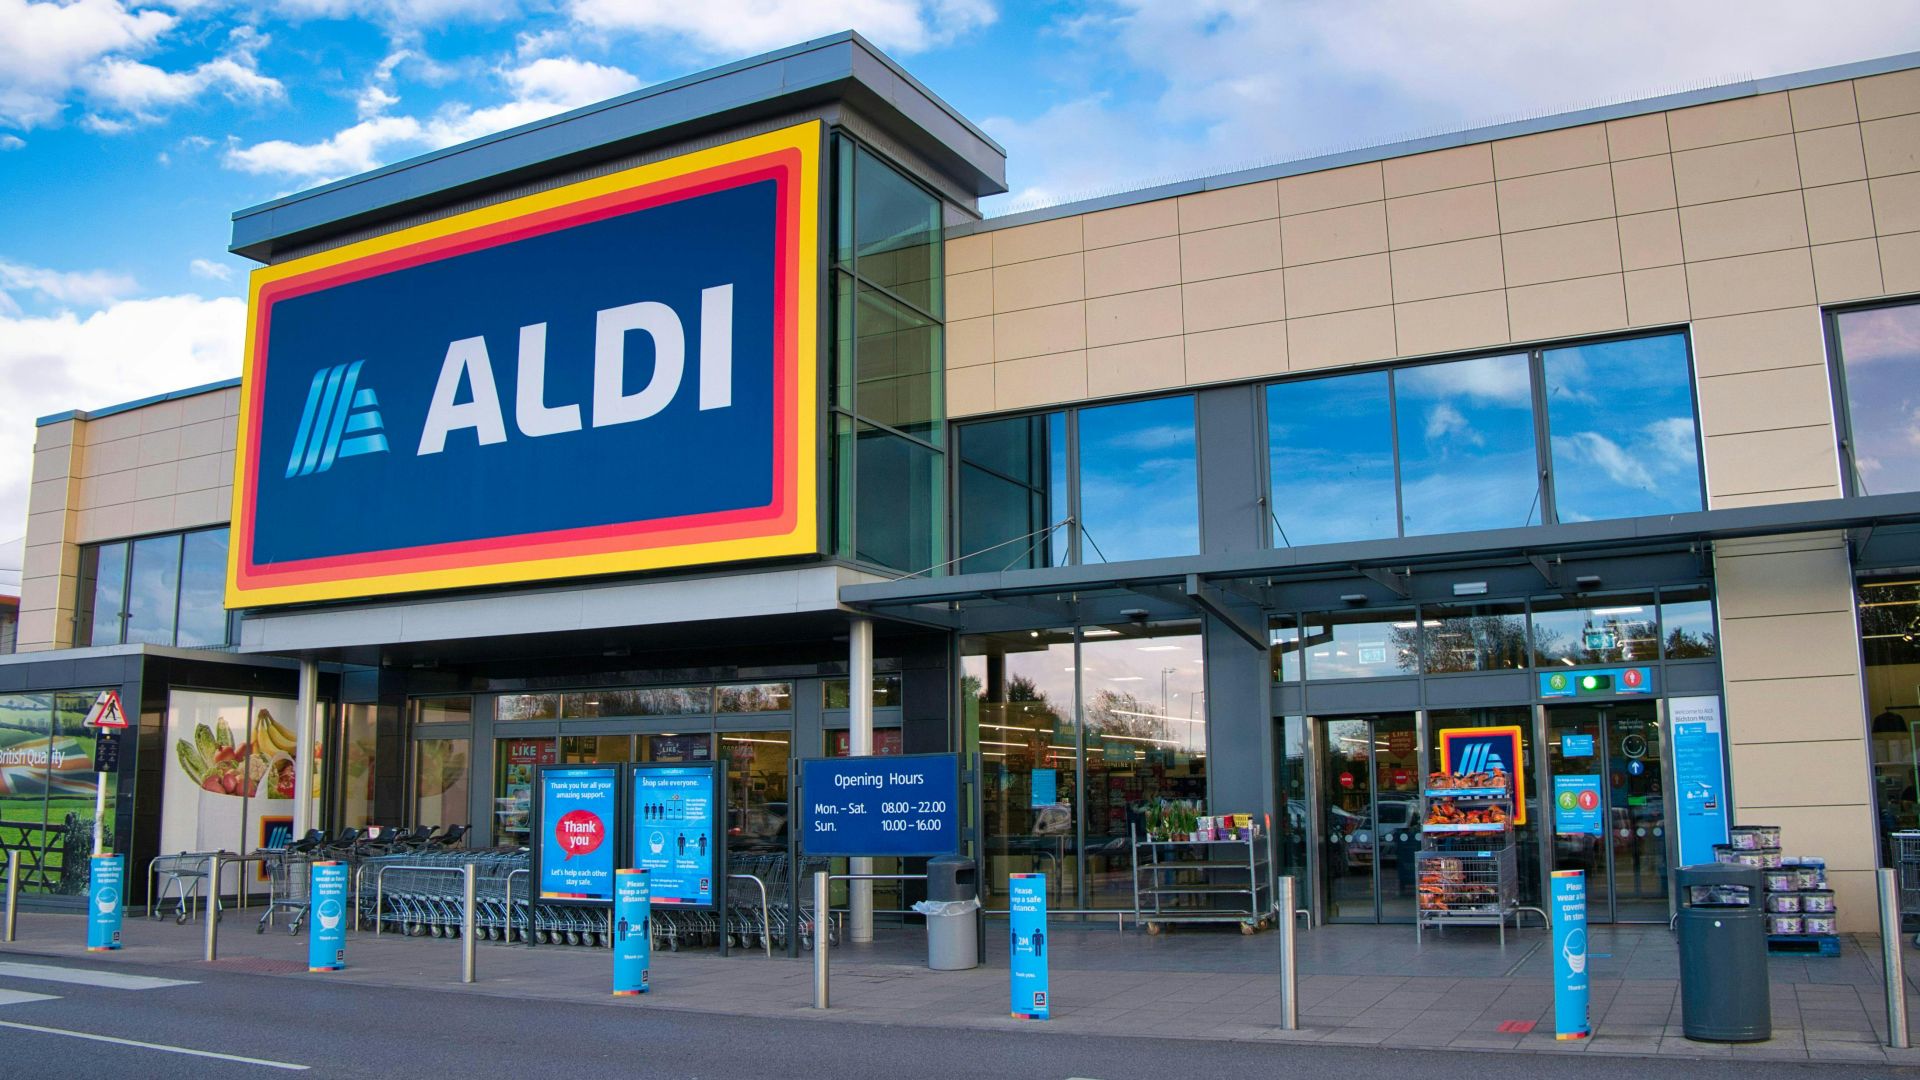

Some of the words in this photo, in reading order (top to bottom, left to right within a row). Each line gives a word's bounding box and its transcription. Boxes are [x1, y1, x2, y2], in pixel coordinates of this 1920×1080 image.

[417, 283, 733, 456] ALDI
[512, 746, 536, 756] LIKE
[642, 779, 656, 788] Shop
[670, 780, 699, 788] everyone.
[834, 772, 882, 789] Opening
[890, 772, 924, 785] Hours
[556, 792, 580, 800] amazing
[814, 804, 839, 814] Mon.
[848, 802, 867, 814] Sat.
[882, 802, 909, 814] 08.00
[918, 801, 946, 813] 22.00
[564, 821, 596, 832] Thank
[814, 820, 836, 832] Sun.
[881, 820, 907, 831] 10.00
[916, 819, 942, 830] 16.00
[570, 836, 589, 848] you
[551, 868, 564, 876] Let's
[564, 869, 577, 878] help
[618, 888, 636, 896] keep
[630, 924, 640, 932] 2M
[1018, 936, 1028, 945] 2M
